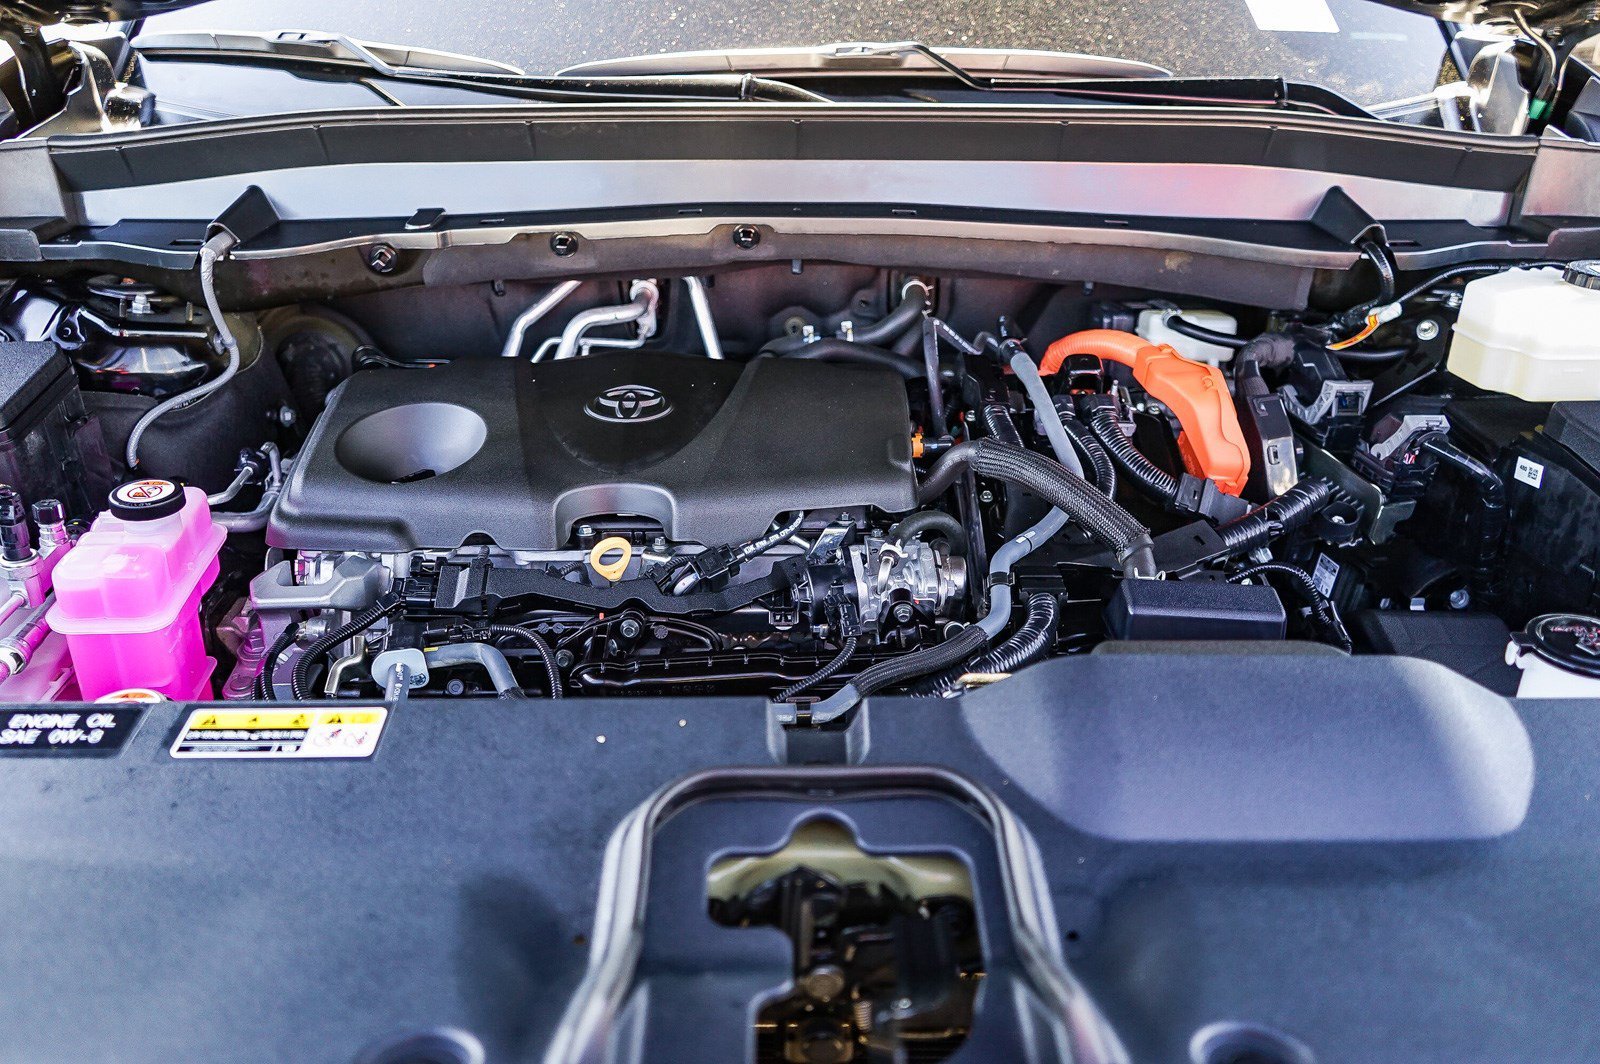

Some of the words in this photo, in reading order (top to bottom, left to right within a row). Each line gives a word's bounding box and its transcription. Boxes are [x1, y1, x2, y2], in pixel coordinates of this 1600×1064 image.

[8, 713, 81, 729] ENGINE
[86, 713, 116, 728] OIL
[0, 728, 42, 744] SAE
